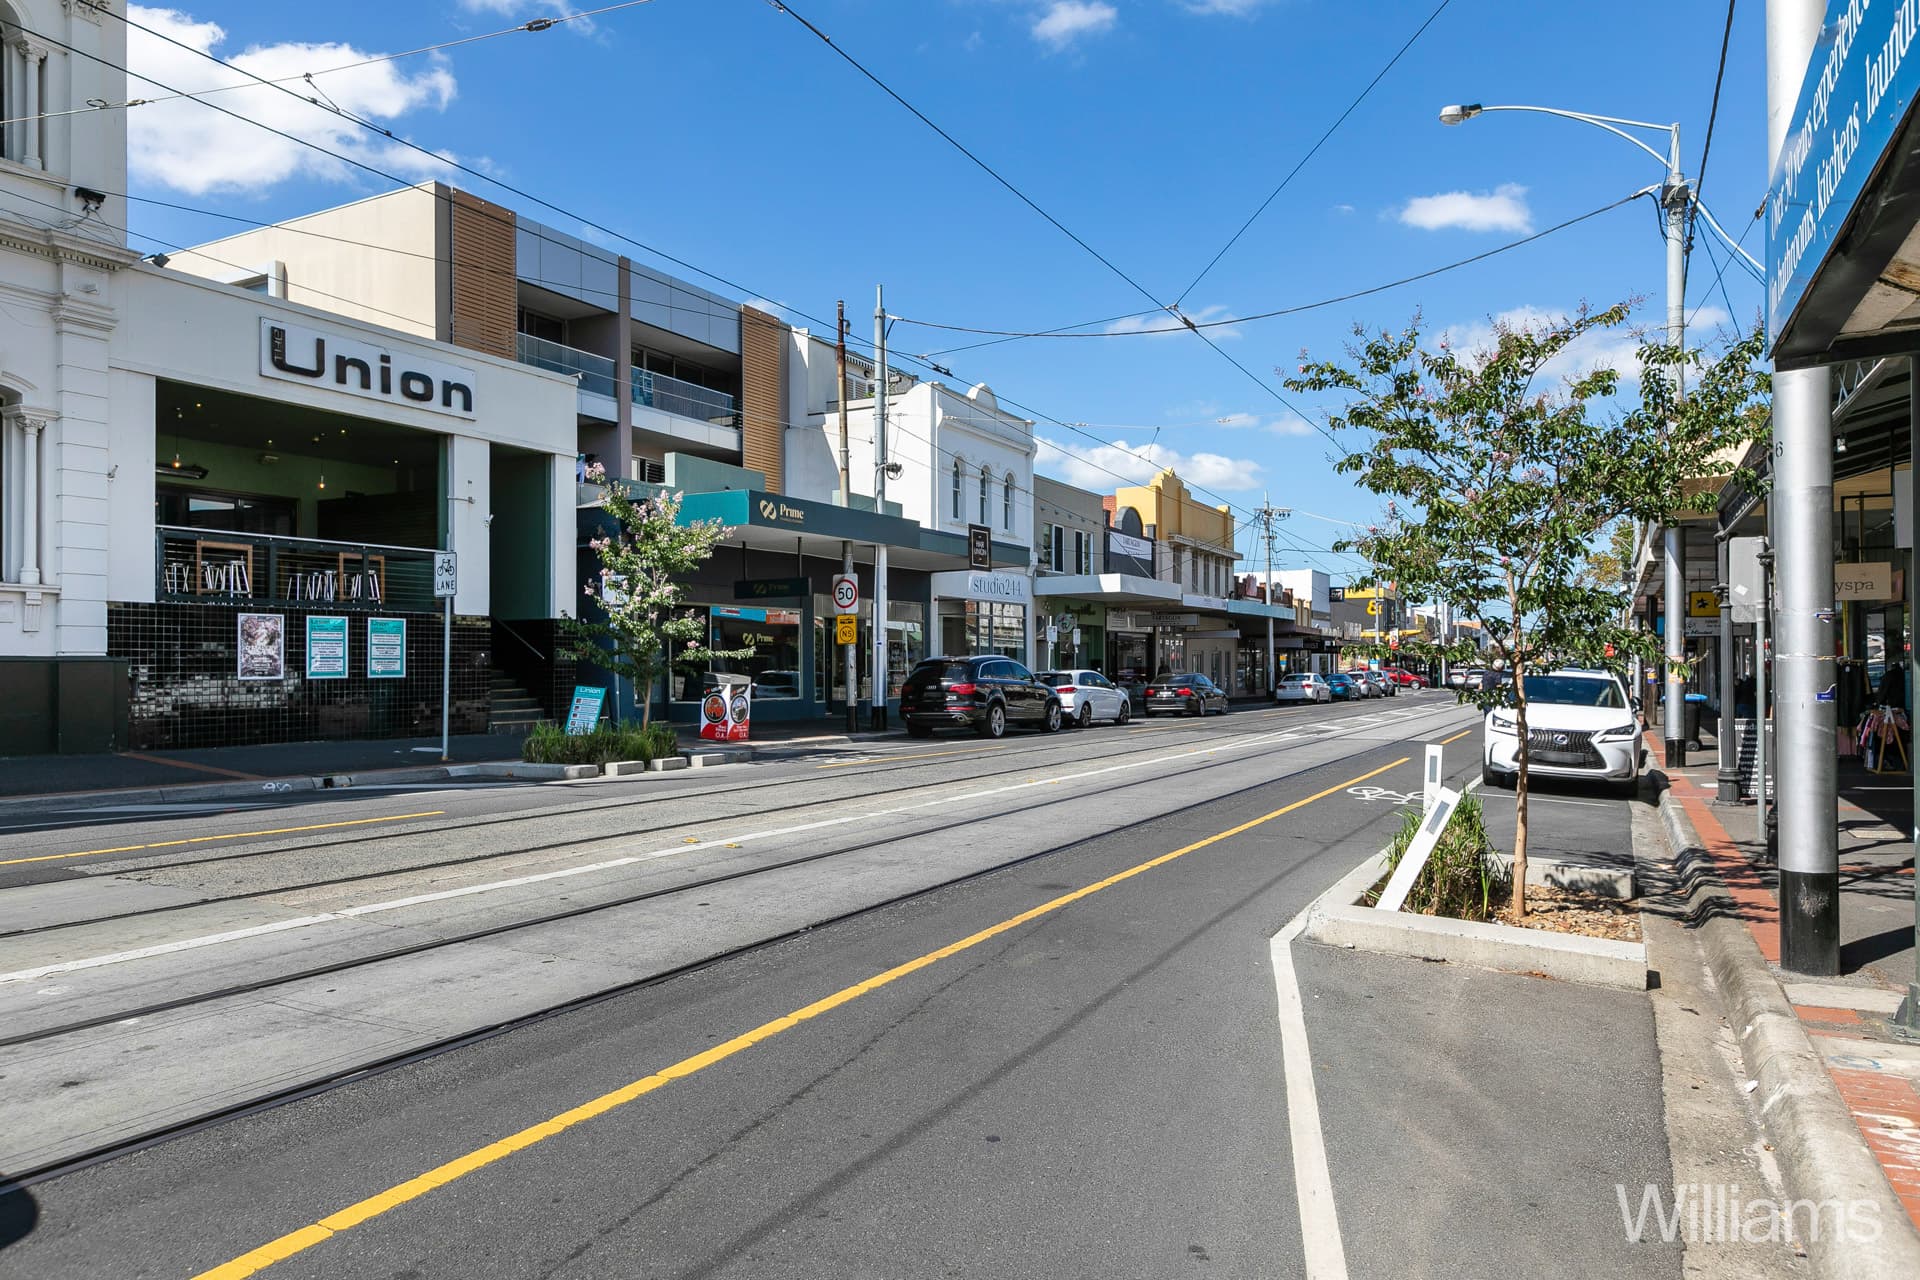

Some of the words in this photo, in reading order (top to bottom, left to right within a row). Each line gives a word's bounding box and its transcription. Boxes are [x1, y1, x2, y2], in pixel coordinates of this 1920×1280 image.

[1793, 109, 1812, 200] years
[1813, 0, 1871, 132] experienc
[1777, 199, 1817, 302] bathrooms,
[1816, 100, 1860, 222] kitchens
[1865, 0, 1920, 124] laund
[271, 326, 473, 412] Union
[1775, 440, 1784, 458] 6
[436, 580, 455, 591] LANE
[838, 587, 854, 601] 50
[1834, 580, 1874, 594] yspa
